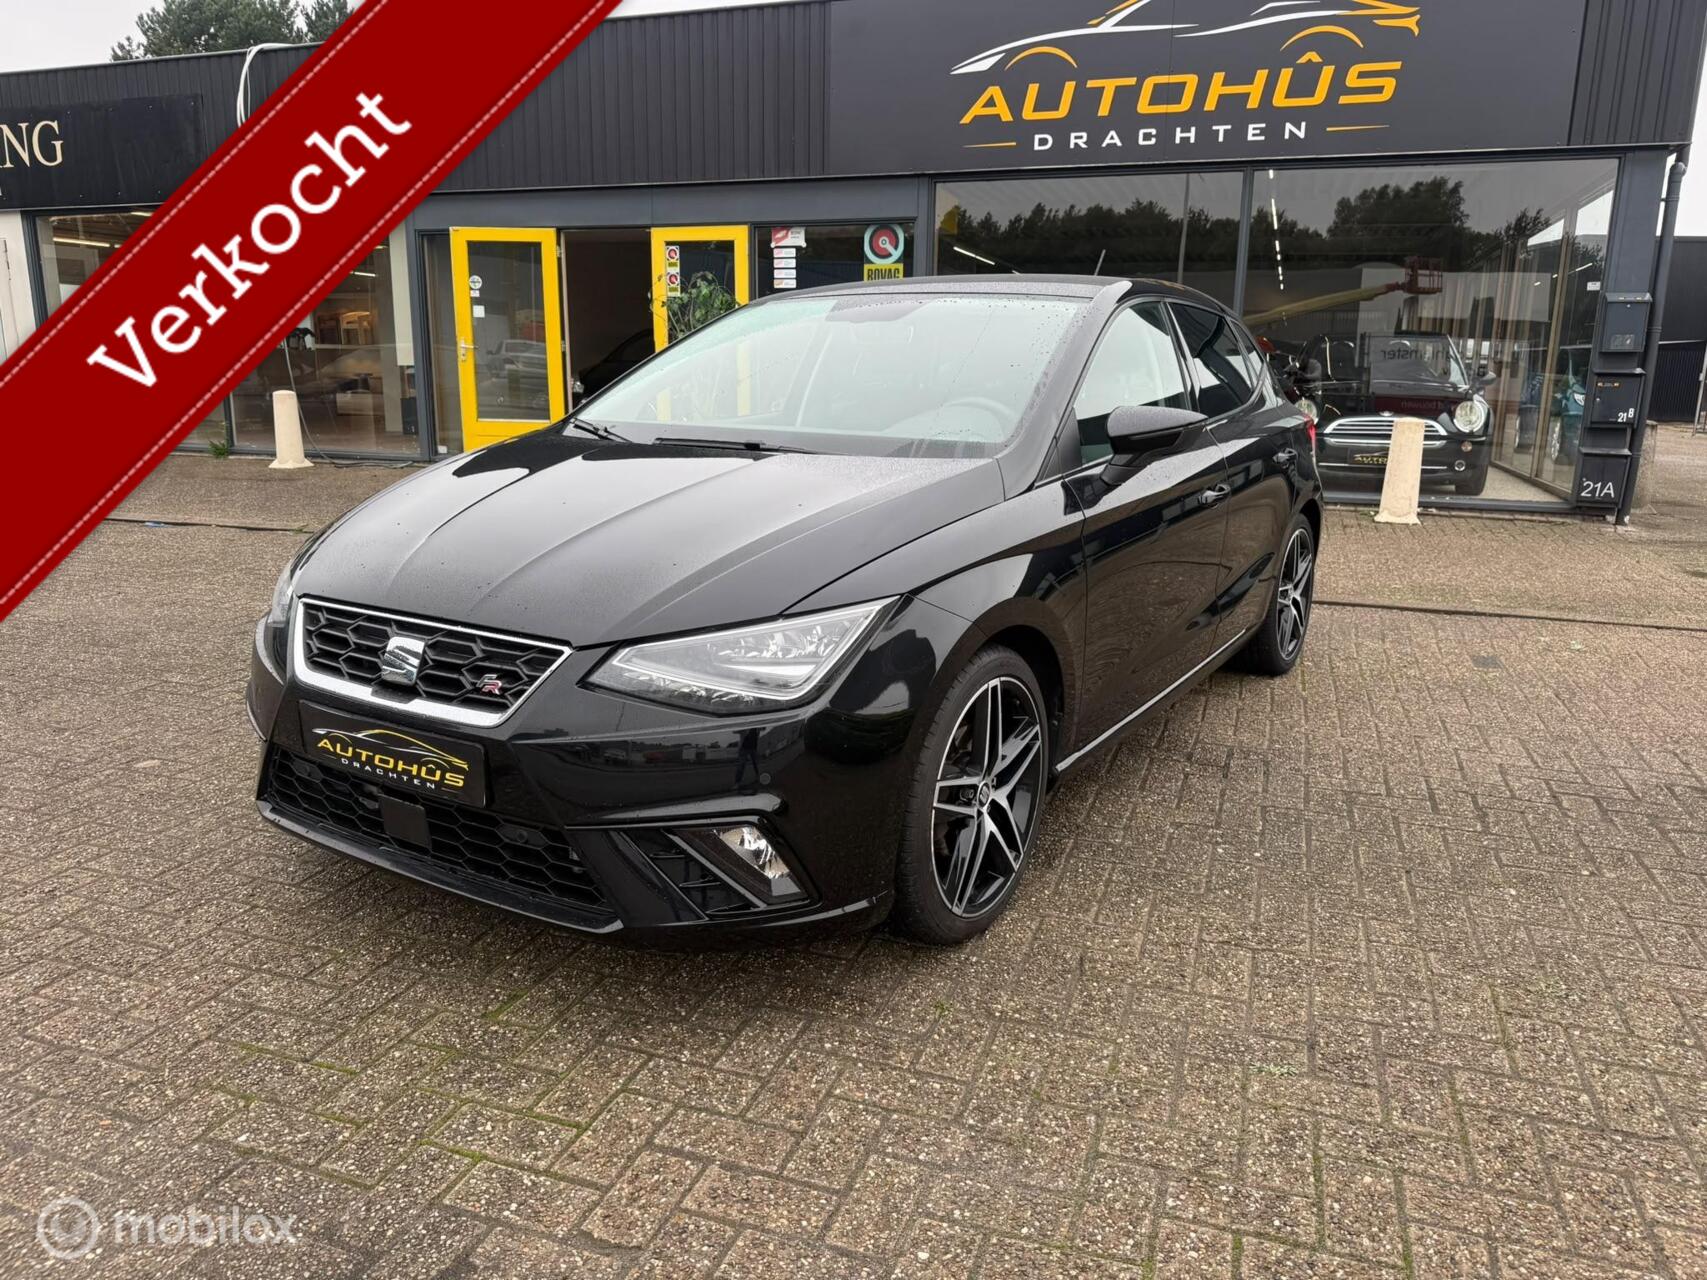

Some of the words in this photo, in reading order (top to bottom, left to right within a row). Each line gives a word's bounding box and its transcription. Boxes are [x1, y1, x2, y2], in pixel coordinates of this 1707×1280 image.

[959, 51, 1402, 124] AUTOHÛS
[1033, 121, 1306, 151] DRACHTEN
[1580, 481, 1615, 498] 21A
[317, 738, 465, 788] AUTOHÛS
[341, 757, 436, 790] DRACHTEN
